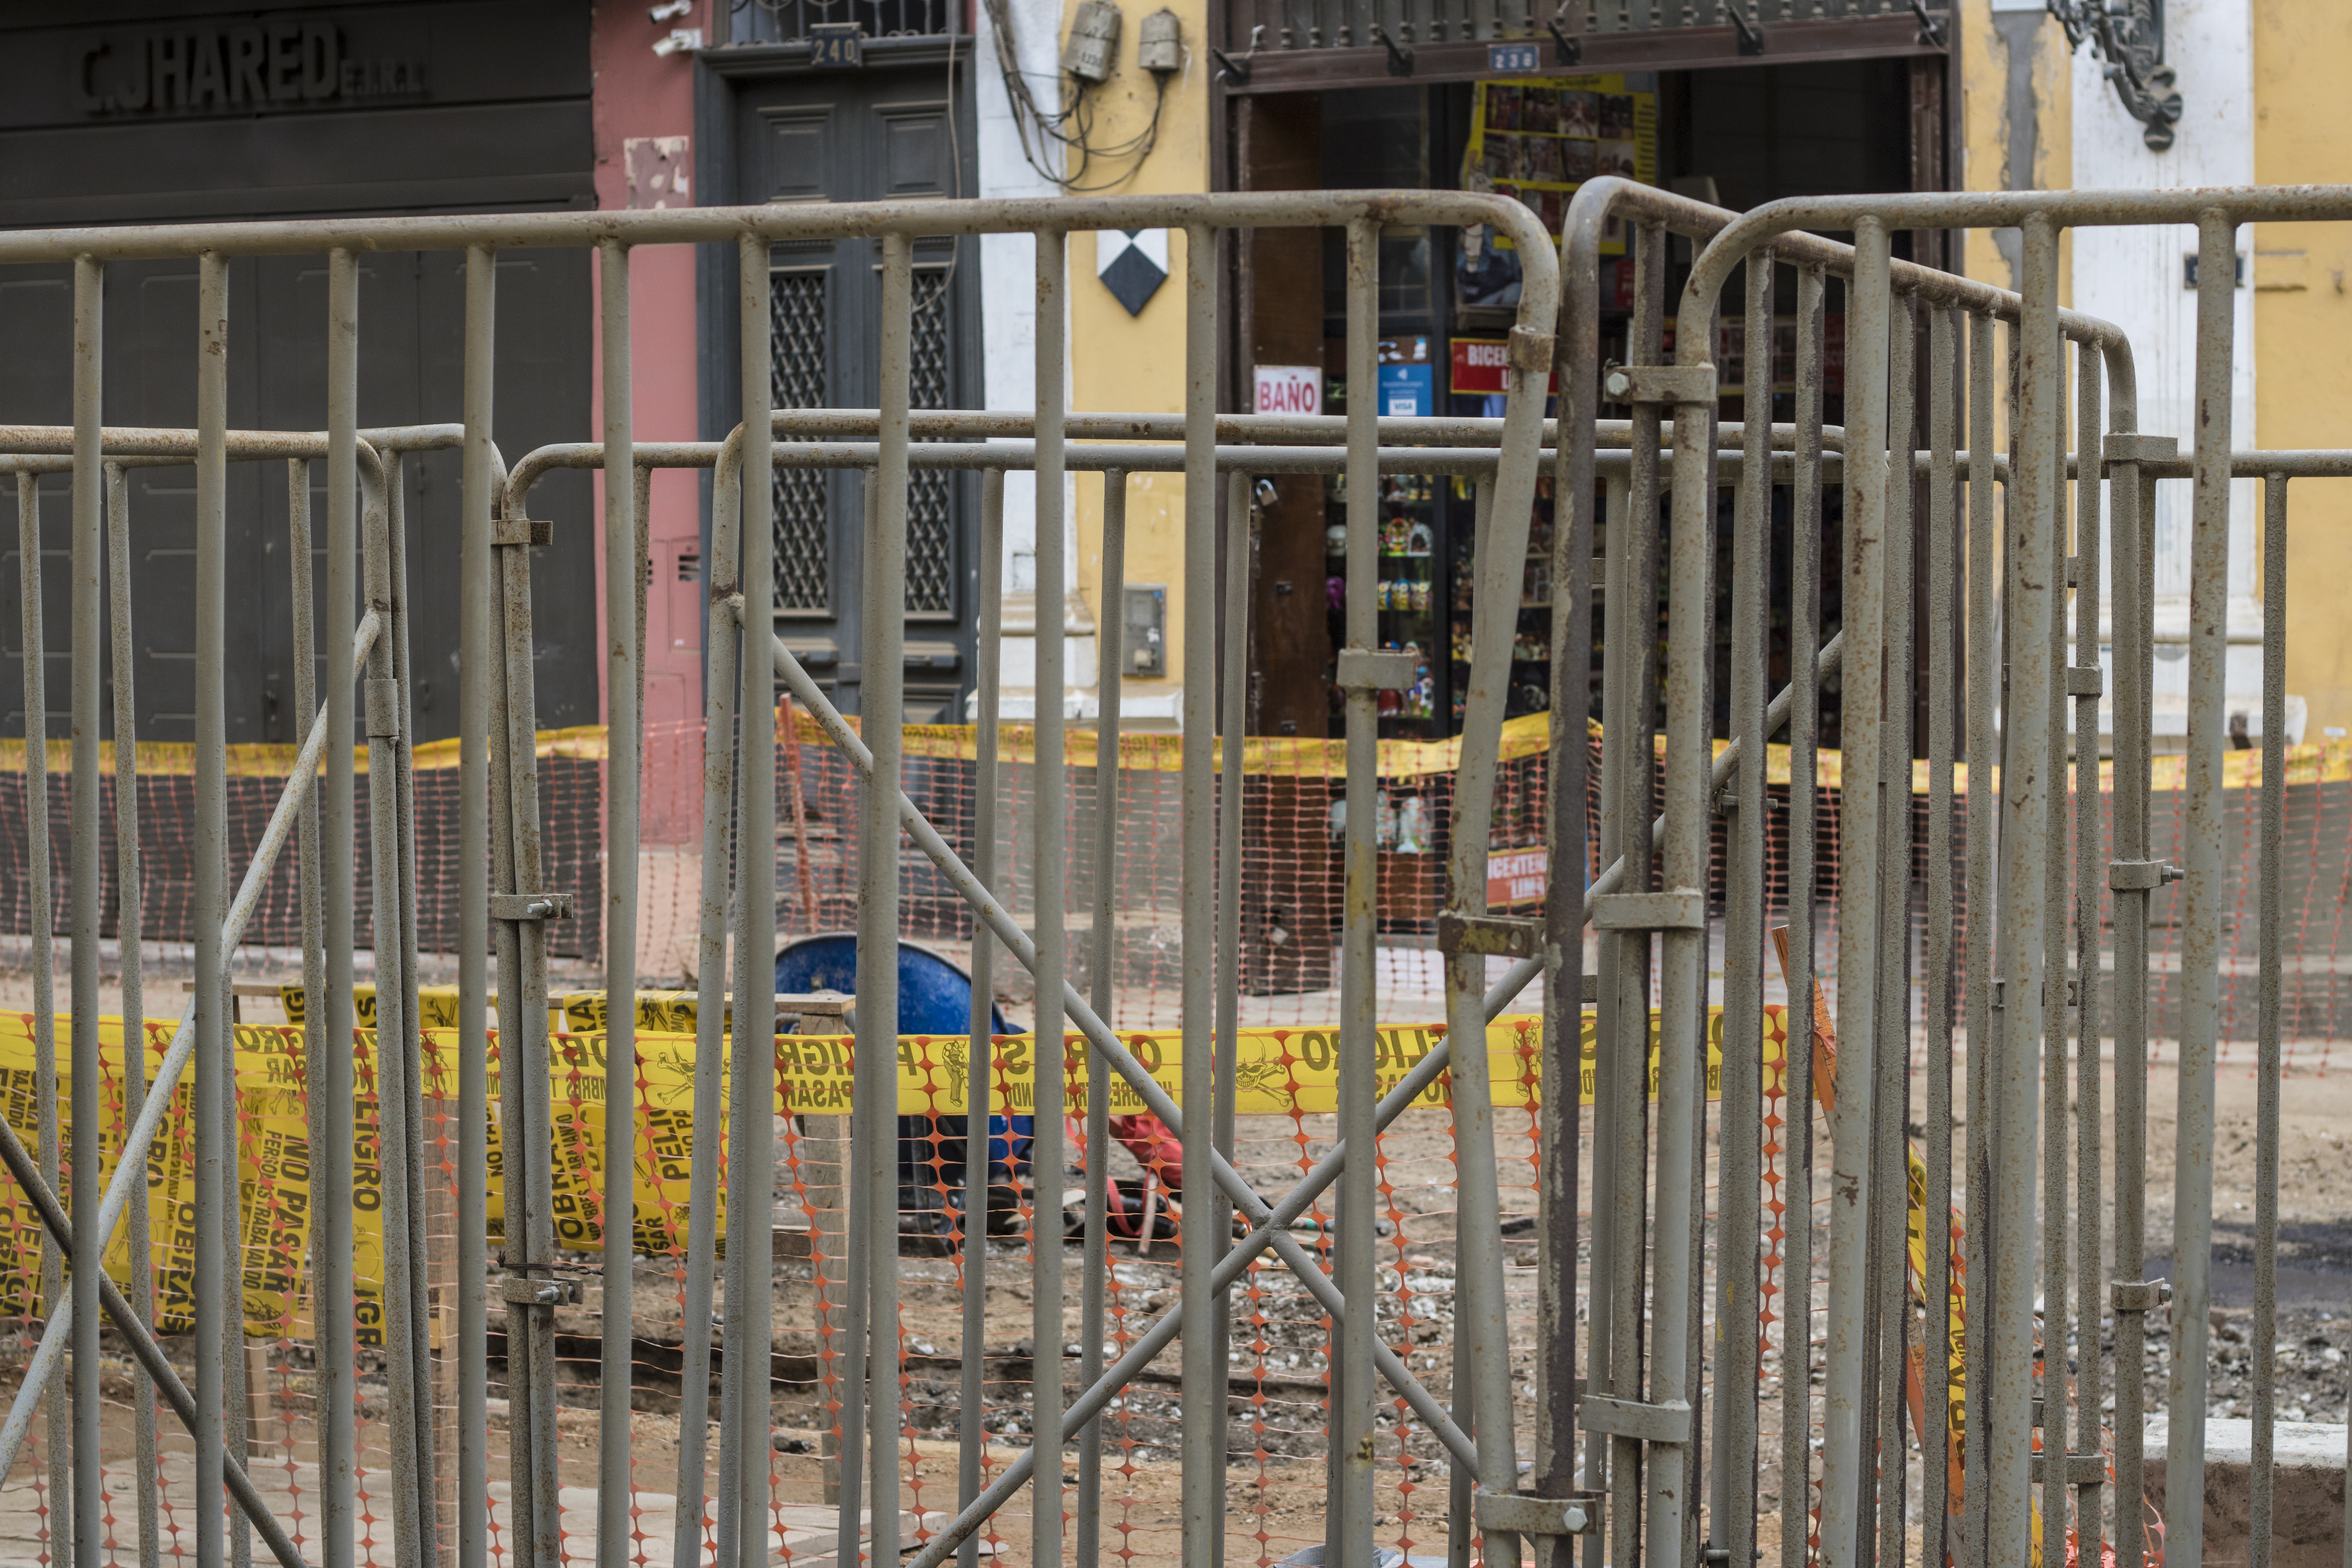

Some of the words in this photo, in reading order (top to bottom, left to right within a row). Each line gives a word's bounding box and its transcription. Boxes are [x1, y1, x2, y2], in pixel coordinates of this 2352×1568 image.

[815, 38, 855, 63] 240
[1259, 375, 1314, 413] BAÑO
[281, 1135, 310, 1182] NO
[263, 1189, 307, 1294] PASAR
[164, 1201, 195, 1331] OBRAS
